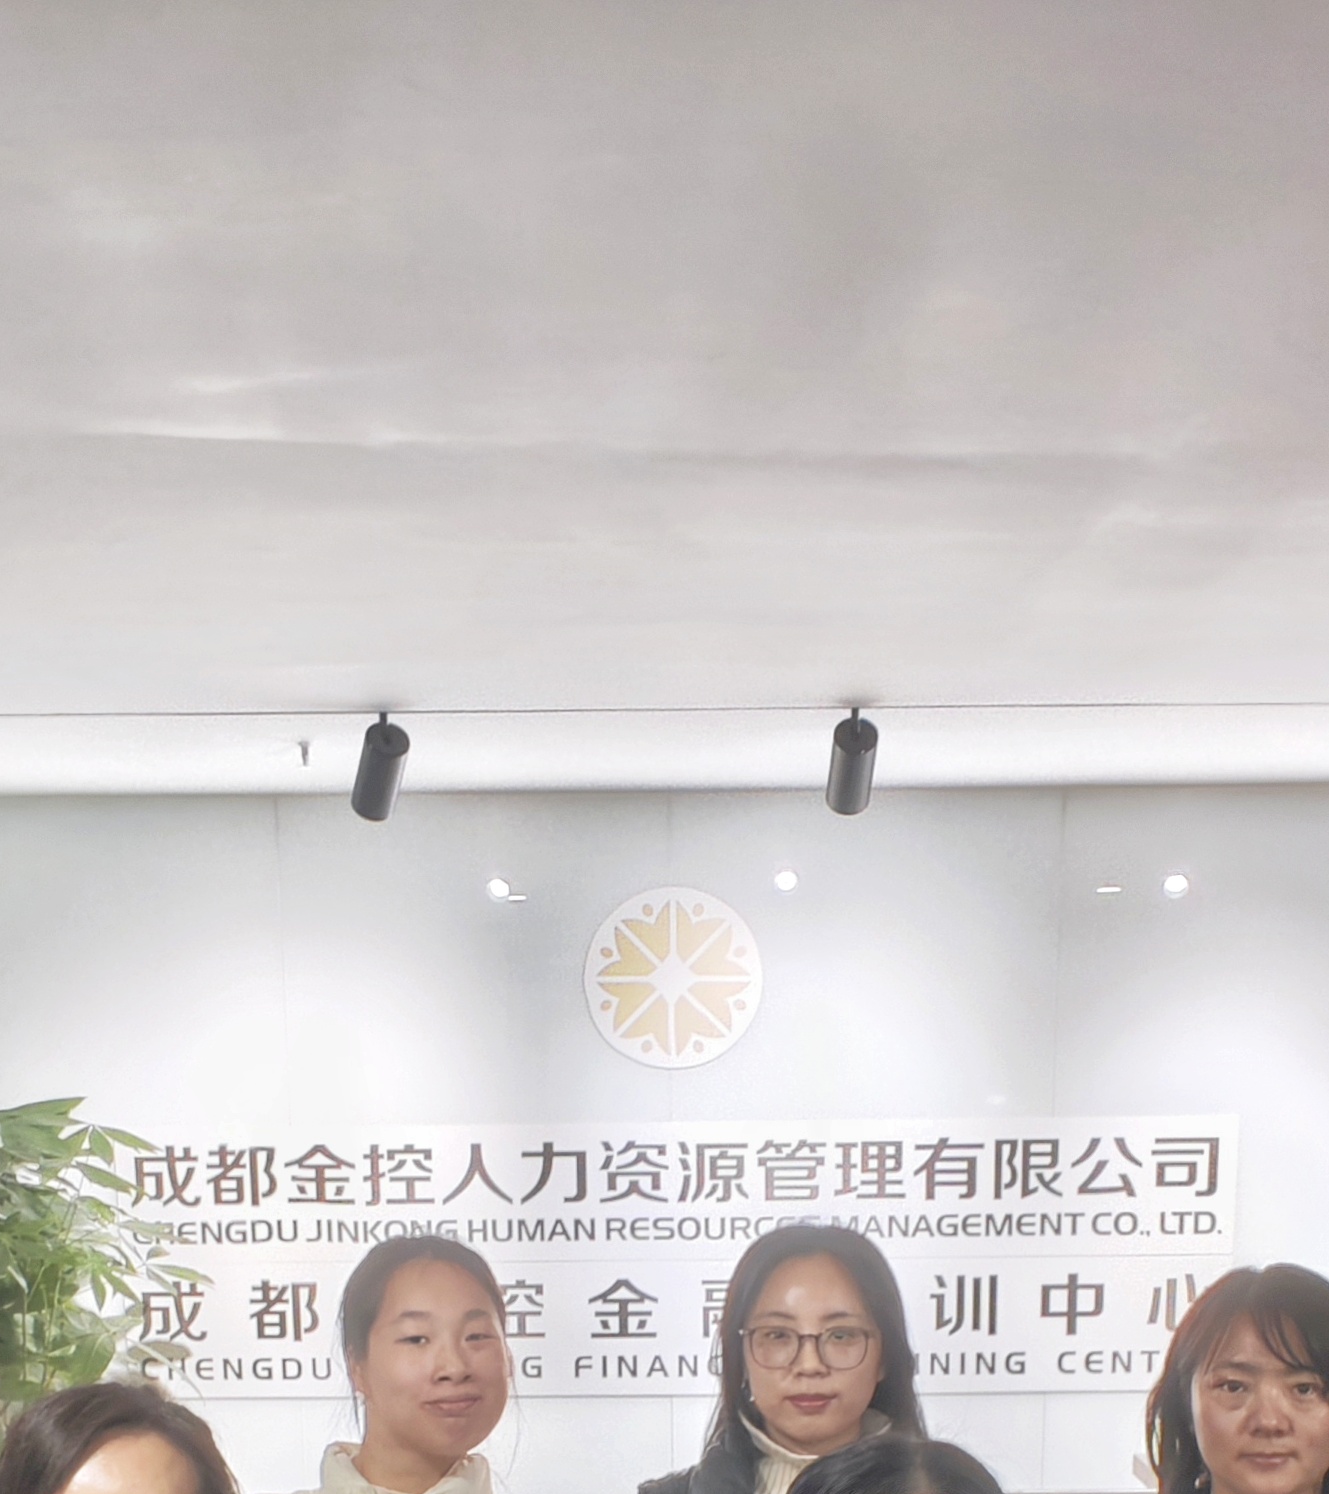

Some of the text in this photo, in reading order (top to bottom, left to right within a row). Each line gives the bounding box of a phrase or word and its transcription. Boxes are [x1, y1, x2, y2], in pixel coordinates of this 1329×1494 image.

[131, 1136, 1221, 1208] 成都金控人力资源管理有限公司
[467, 1217, 596, 1243] HUMAN
[1159, 1210, 1223, 1235] LTD.
